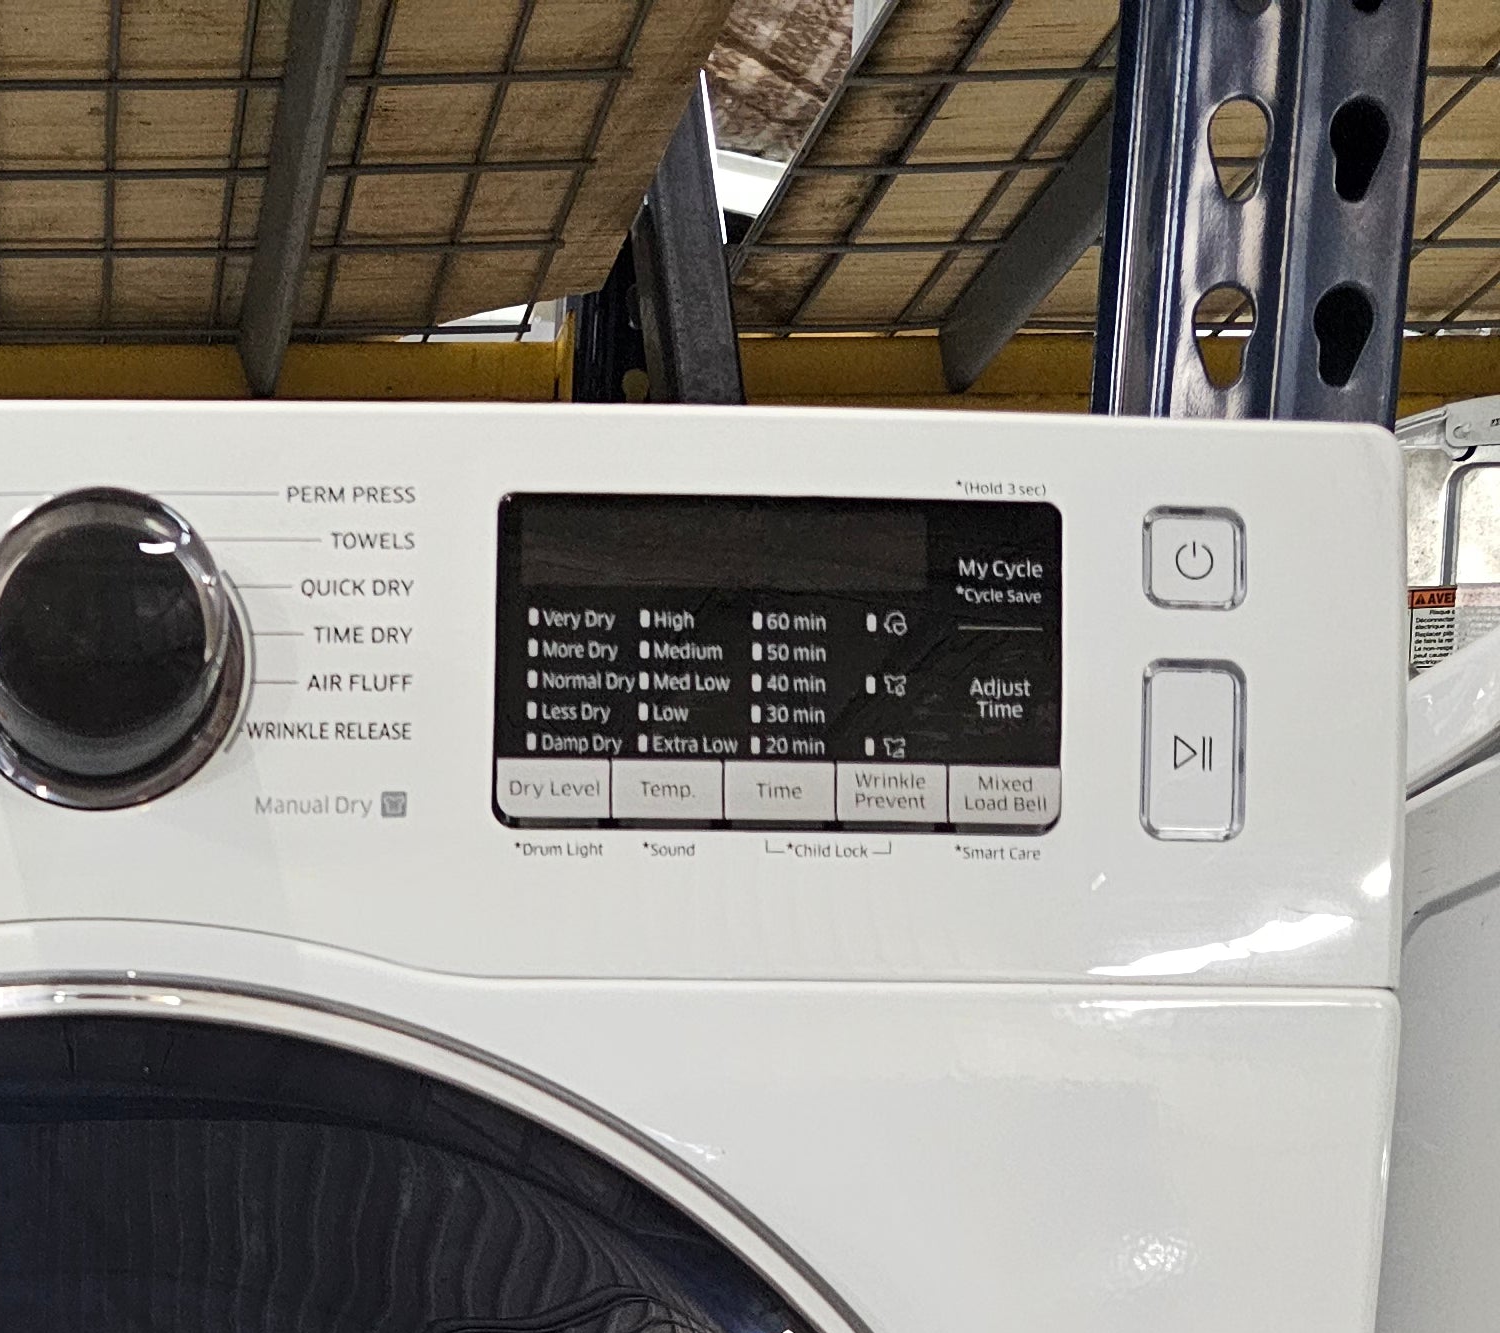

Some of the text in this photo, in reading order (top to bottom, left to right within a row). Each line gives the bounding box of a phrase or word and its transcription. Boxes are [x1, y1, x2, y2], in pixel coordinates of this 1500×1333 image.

[288, 486, 415, 503] PERM PRESS
[331, 532, 414, 549] TOWELS
[959, 559, 1043, 580] My Cycle
[301, 579, 413, 598] QUICK DRY
[1007, 590, 1041, 603] Save
[543, 609, 615, 630] Very Dry
[654, 610, 694, 631] High
[767, 612, 826, 631] 60 min
[314, 627, 412, 643] TIME DRY
[543, 640, 618, 661] More Dry
[654, 642, 722, 660] Medium
[767, 644, 826, 662] 50 min
[308, 674, 411, 691] AIR FLUFF
[542, 671, 635, 693] Normal Dry
[654, 673, 730, 692] Med Low
[767, 674, 826, 692] 40 min
[970, 678, 1030, 700] Adjust
[542, 703, 610, 724] Less Dry
[653, 704, 688, 721] Low
[767, 705, 825, 723] 30 min
[977, 700, 1023, 718] Time
[246, 722, 410, 740] WRINKLE RELEASE
[542, 733, 622, 755] Damp Dry
[653, 735, 738, 753] Extra Low
[766, 736, 825, 754] 20 min
[510, 780, 599, 799] Dry Level
[855, 773, 925, 789] Wrinkle
[979, 776, 1032, 792] Mixed
[641, 781, 695, 800] Temp.
[756, 783, 802, 799] Time
[255, 796, 372, 817] Manual Dry
[855, 793, 924, 809] Prevent
[965, 796, 1046, 811] Load Bell
[567, 843, 603, 858] Light
[836, 845, 867, 857] Lock
[1010, 848, 1040, 860] Care
